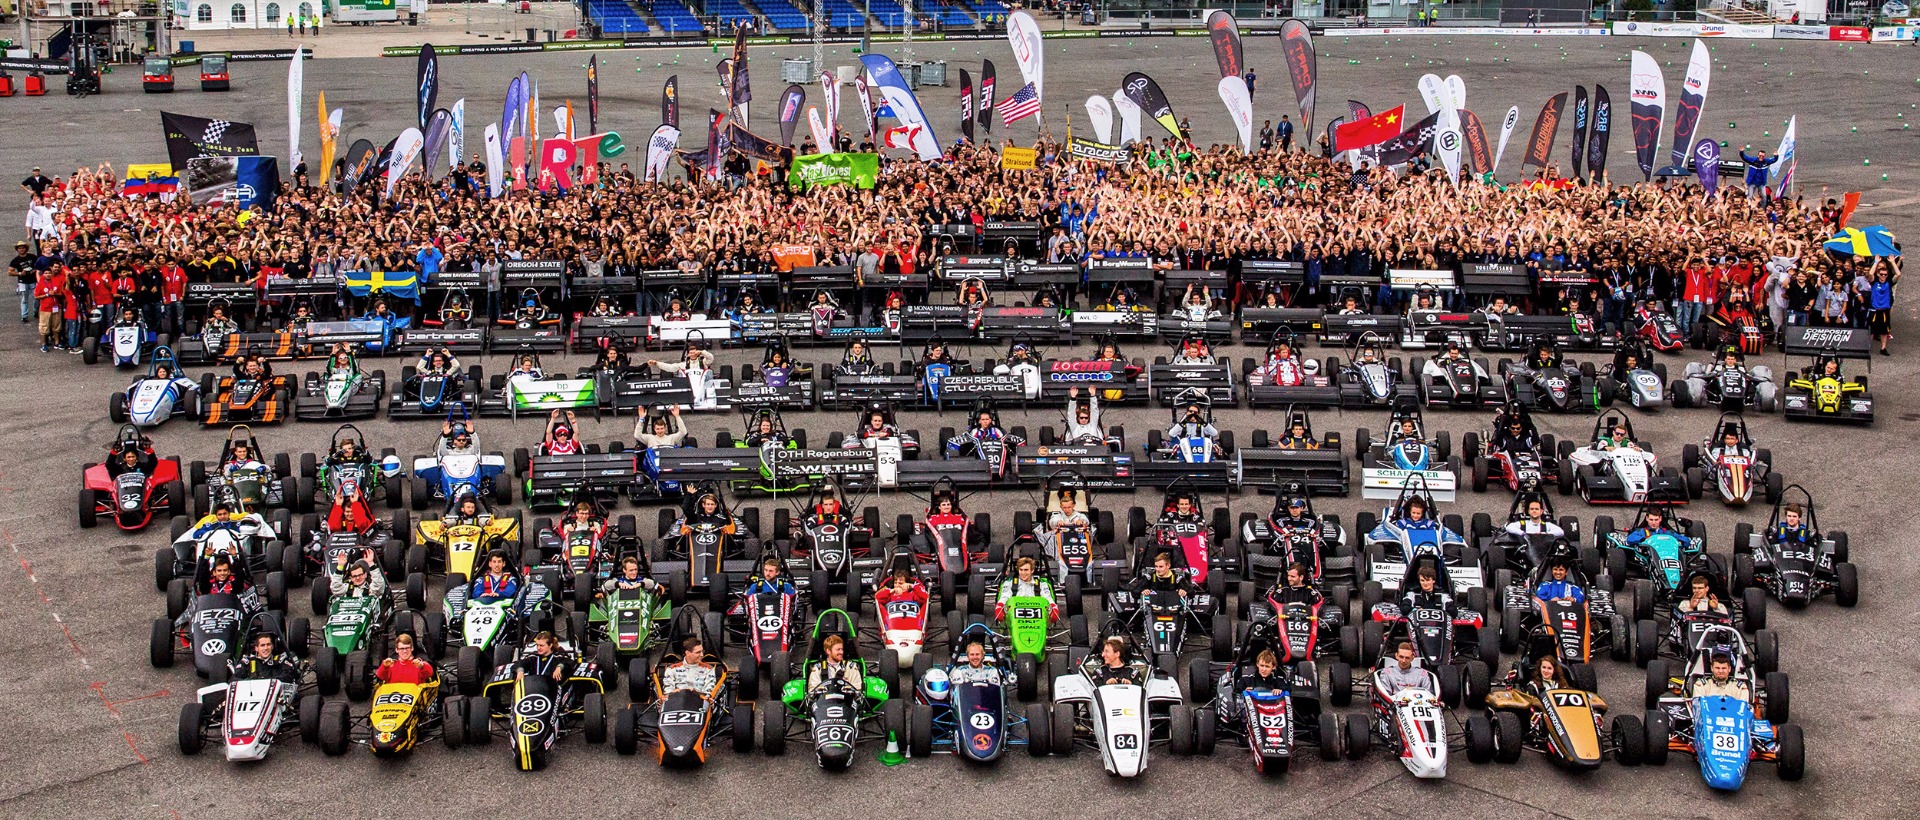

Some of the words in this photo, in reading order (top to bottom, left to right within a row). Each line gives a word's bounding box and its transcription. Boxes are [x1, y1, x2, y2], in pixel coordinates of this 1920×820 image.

[1005, 158, 1032, 166] Stralsund
[1802, 333, 1851, 342] DESIGN
[1052, 361, 1113, 371] LOCTITE
[976, 375, 1018, 384] REPUBLIC
[1051, 373, 1113, 381] RACEPREP
[967, 384, 1019, 392] CARTECH
[808, 449, 872, 458] Regensburg
[122, 494, 141, 502] 32
[1176, 524, 1197, 532] E19
[1063, 546, 1088, 554] E53
[1790, 581, 1804, 590] RS14
[200, 610, 235, 620] E72
[1015, 608, 1042, 618] E31
[1419, 611, 1441, 620] 85
[1558, 612, 1577, 620] 18
[760, 619, 780, 627] 46
[1154, 622, 1176, 631] 63
[1288, 622, 1309, 630] E66
[377, 694, 412, 705] E65
[1555, 694, 1583, 705] 70
[237, 701, 260, 712] 117
[520, 699, 546, 712] 89
[1412, 706, 1432, 717] E96
[662, 712, 701, 723] E21
[975, 715, 990, 726] 23
[1262, 716, 1283, 727] 52
[1546, 706, 1565, 735] PFORZHEIM
[817, 727, 852, 744] E67
[1117, 736, 1135, 747] 84
[1716, 736, 1734, 748] 38
[1711, 749, 1740, 758] Brunel
